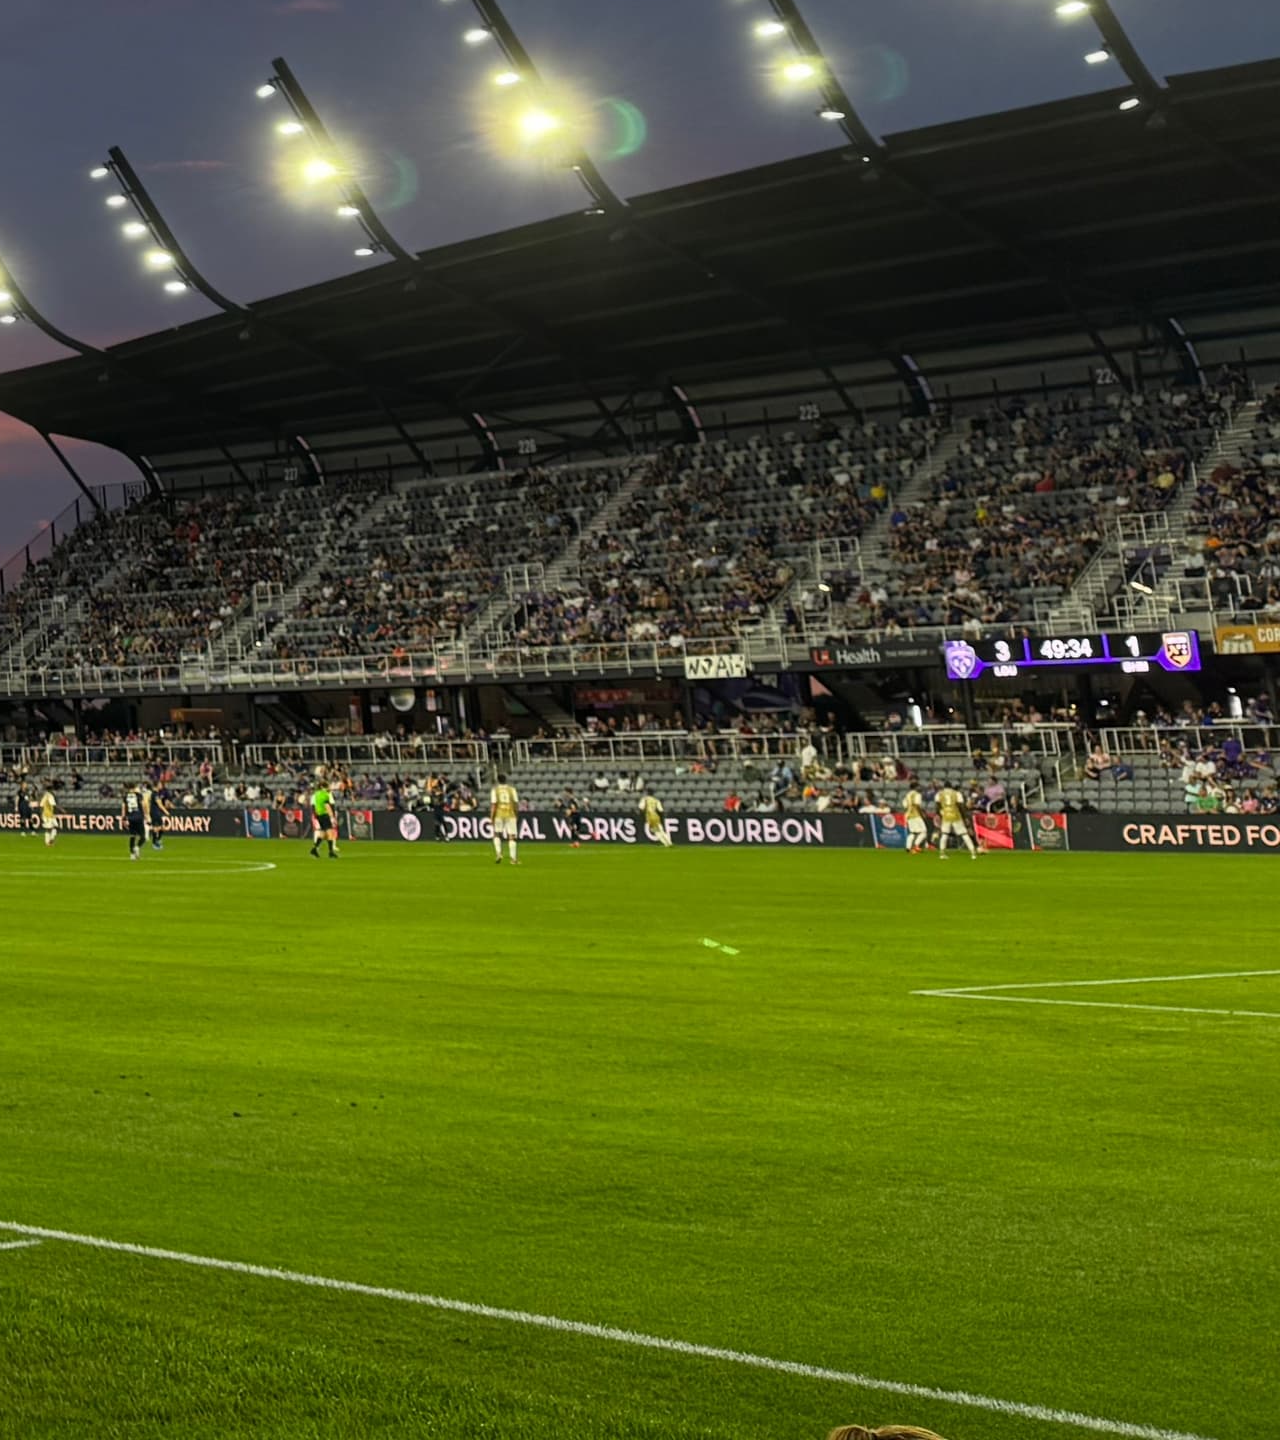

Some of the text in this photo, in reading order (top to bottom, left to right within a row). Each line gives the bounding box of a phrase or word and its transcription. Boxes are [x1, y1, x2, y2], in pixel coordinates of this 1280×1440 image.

[836, 647, 881, 665] Health
[994, 641, 1011, 662] 3
[1040, 638, 1093, 660] 49:34
[1126, 636, 1140, 657] 1
[993, 665, 1018, 677] LOU
[89, 815, 115, 830] FOR
[161, 815, 211, 832] DINARY
[441, 816, 546, 840] ORIGAL
[688, 818, 824, 844] BOURBON
[1123, 824, 1240, 846] CRAFTED
